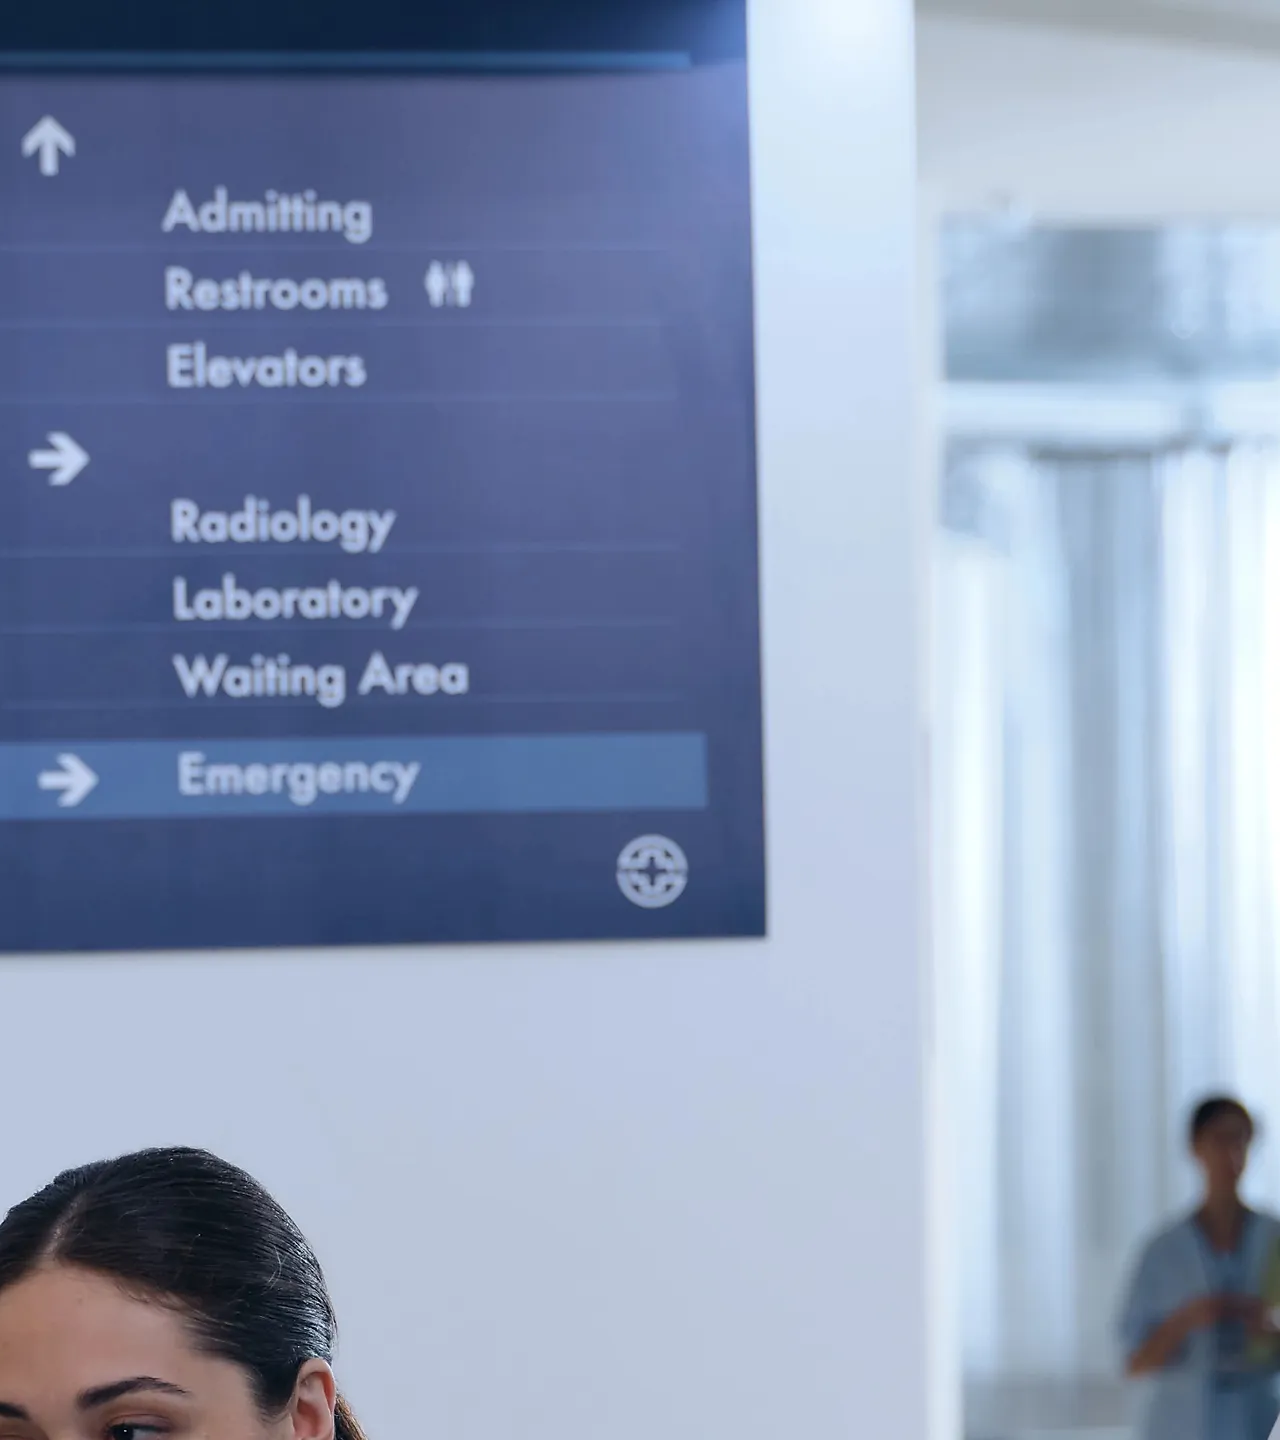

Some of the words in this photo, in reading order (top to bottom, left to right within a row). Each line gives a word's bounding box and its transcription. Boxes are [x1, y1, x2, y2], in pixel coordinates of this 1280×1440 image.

[162, 186, 373, 244] Admitting
[165, 266, 388, 311] Restrooms
[166, 342, 367, 388] Elevators
[170, 495, 396, 552] Radiology
[172, 573, 419, 629] Laboratory
[173, 654, 347, 708] Waiting
[357, 652, 469, 695] Area
[177, 751, 421, 805] Emergency
